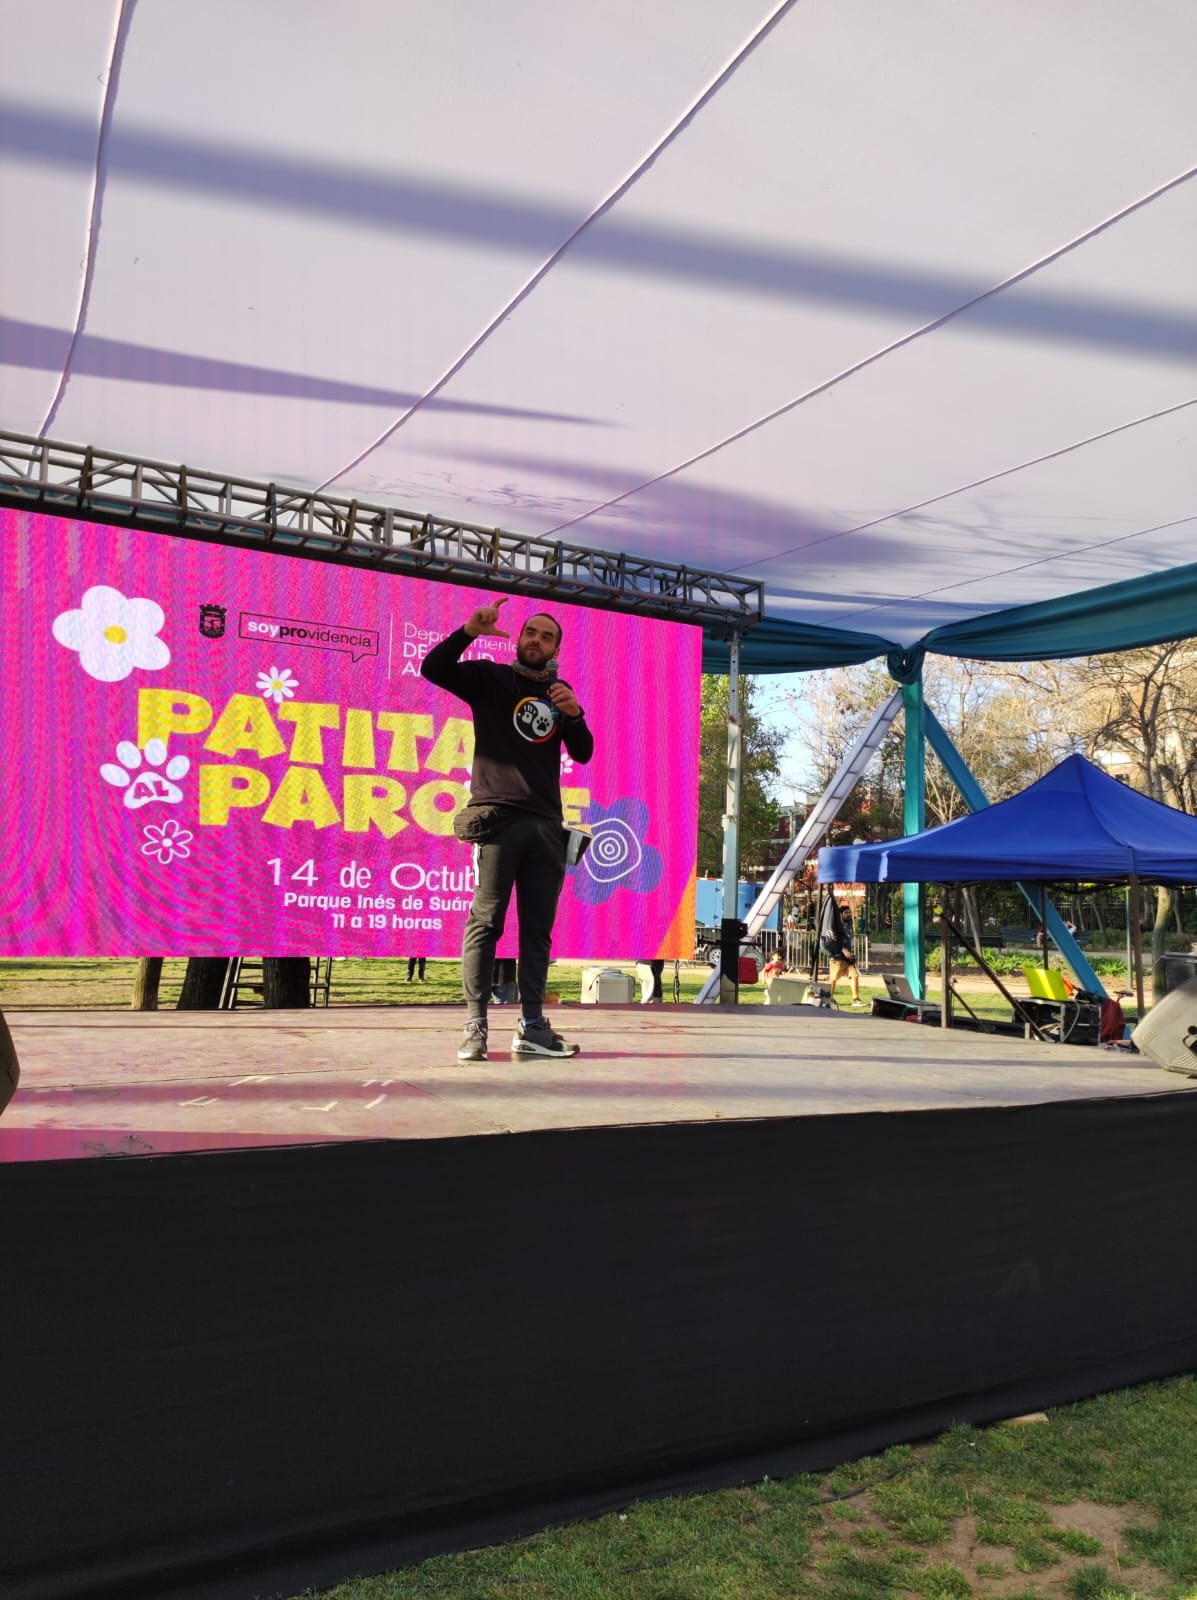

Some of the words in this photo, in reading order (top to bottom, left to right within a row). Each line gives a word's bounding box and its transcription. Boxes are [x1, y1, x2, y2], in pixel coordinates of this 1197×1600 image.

[247, 620, 371, 648] soyprovidencia
[137, 688, 475, 776] PATITA
[133, 780, 169, 799] AL
[199, 764, 591, 843] PARQE
[267, 858, 319, 887] 14
[340, 860, 372, 889] de
[390, 863, 474, 892] Octub
[284, 892, 352, 911] Parque
[358, 894, 396, 910] Inés
[402, 895, 424, 911] de
[429, 896, 473, 912] Suár
[332, 914, 345, 928] 11
[351, 916, 362, 928] a
[369, 914, 386, 929] 19
[392, 915, 443, 930] horas
